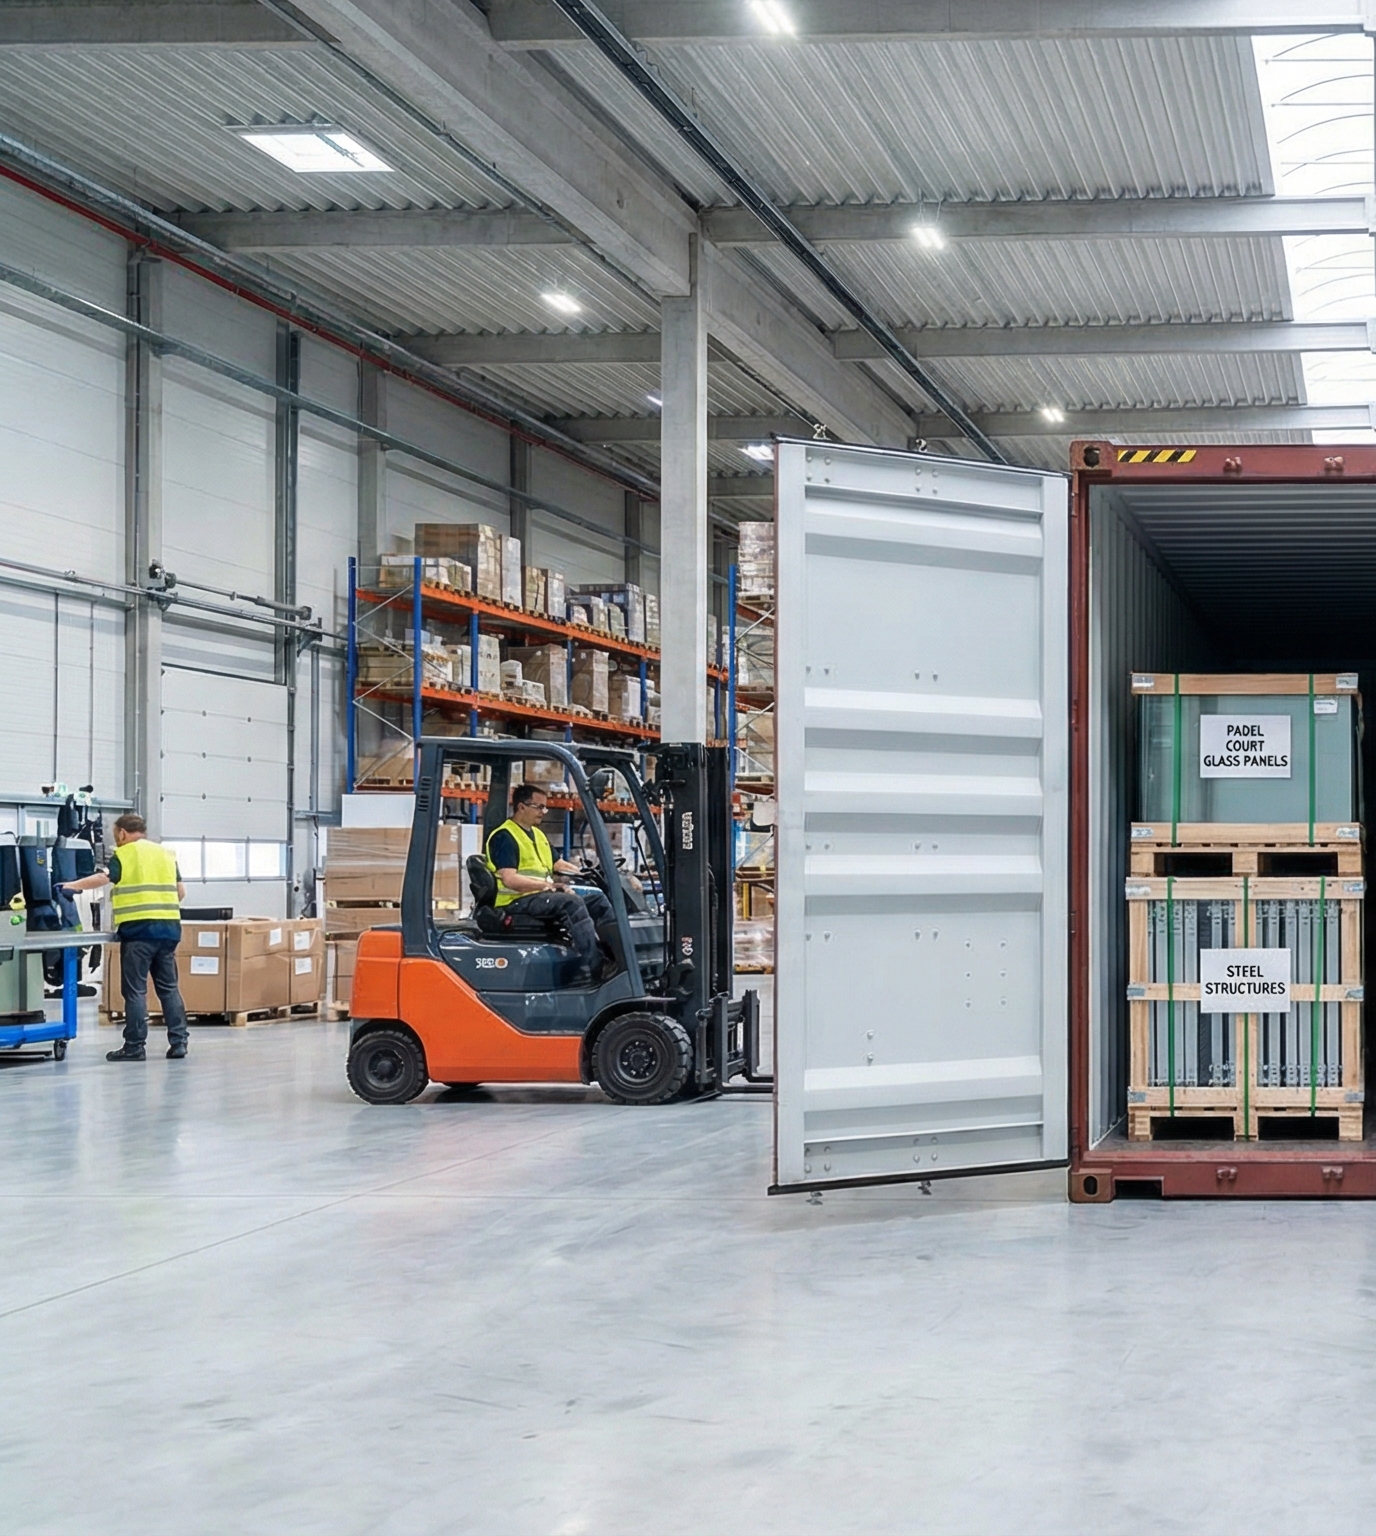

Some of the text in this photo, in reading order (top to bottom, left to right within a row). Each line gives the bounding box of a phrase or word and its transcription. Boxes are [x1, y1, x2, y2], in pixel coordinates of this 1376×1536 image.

[1226, 724, 1265, 737] PADEL
[1225, 739, 1265, 752] COURT
[1203, 754, 1288, 767] GLASS PANELS
[1226, 964, 1264, 978] STEEL
[1205, 981, 1286, 995] STRUCTURES
